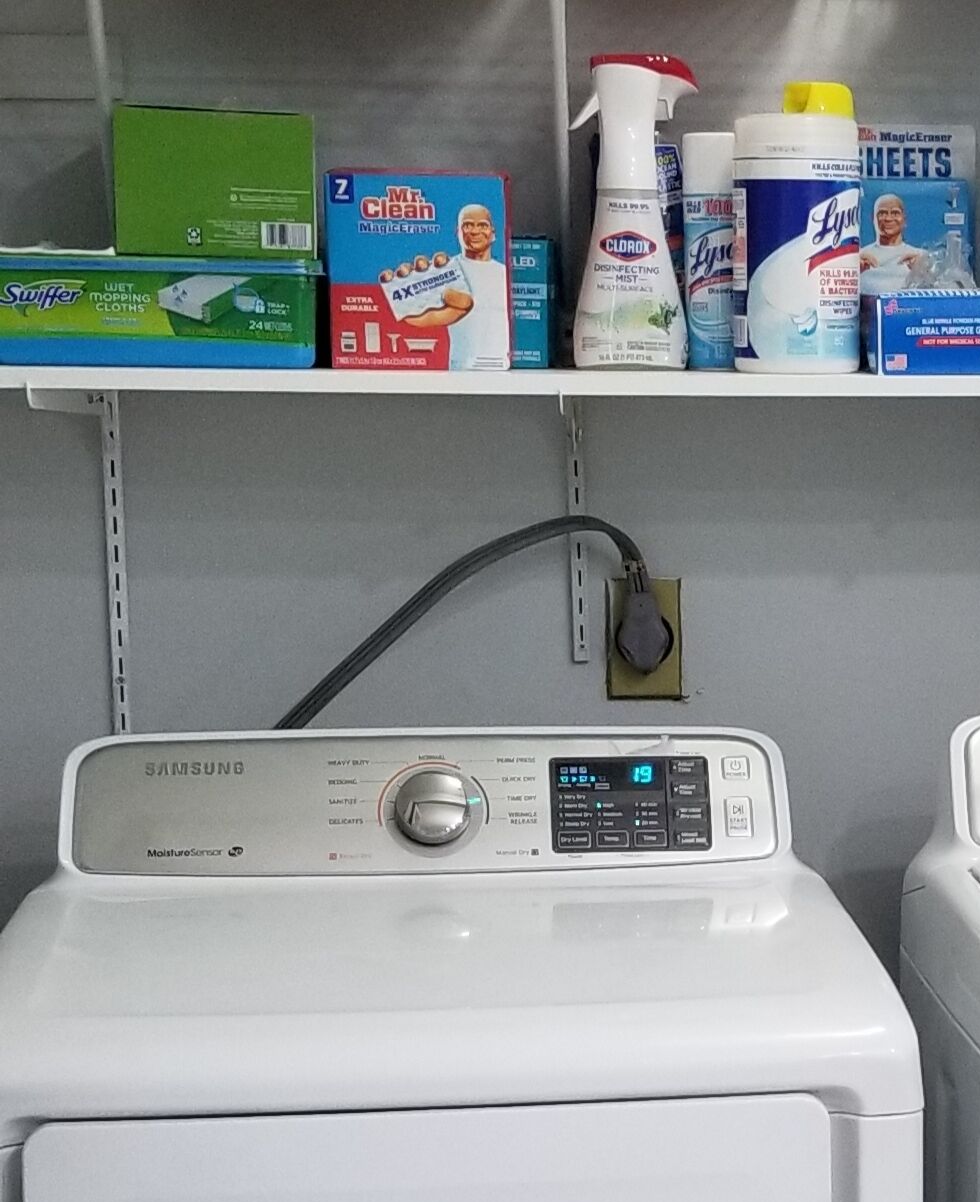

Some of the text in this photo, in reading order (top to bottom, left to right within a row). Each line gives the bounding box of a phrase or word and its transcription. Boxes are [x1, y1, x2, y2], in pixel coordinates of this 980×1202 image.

[335, 179, 348, 194] 7
[387, 187, 424, 203] Mr.
[361, 197, 435, 220] Clean
[811, 197, 859, 246] Lyso
[605, 239, 650, 254] CLOROX
[513, 256, 536, 268] LED
[689, 236, 733, 277] Lyso
[594, 263, 660, 275] DISINFECTING
[615, 274, 639, 284] MIST
[105, 283, 134, 293] WET
[392, 284, 415, 302] 4X
[829, 287, 858, 295] BACTERI
[0, 282, 83, 310] Swiffer
[90, 292, 151, 303] MOPPING
[95, 302, 145, 313] CLOTHS
[249, 320, 263, 331] 24
[906, 326, 940, 336] GENERAL
[941, 326, 974, 335] PURPOSE
[145, 761, 245, 777] SAMSUNG
[633, 765, 653, 783] 19
